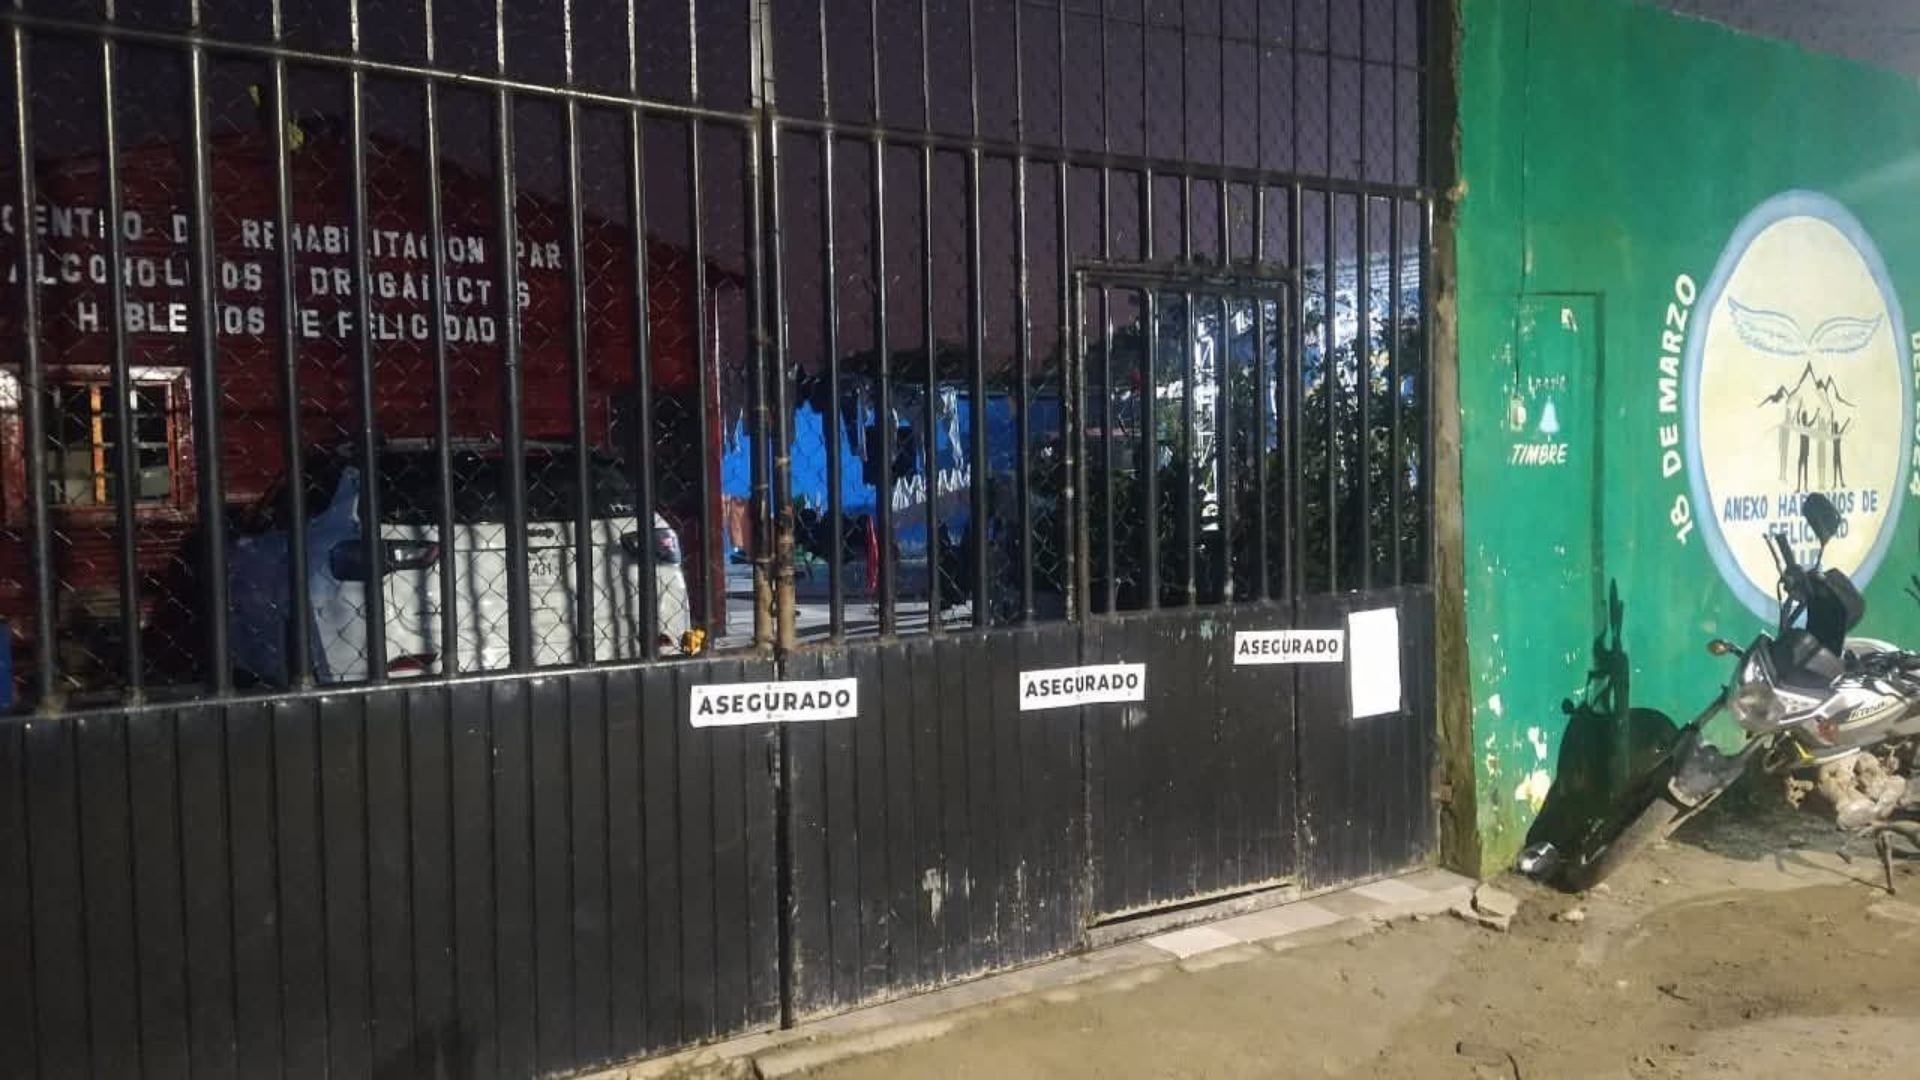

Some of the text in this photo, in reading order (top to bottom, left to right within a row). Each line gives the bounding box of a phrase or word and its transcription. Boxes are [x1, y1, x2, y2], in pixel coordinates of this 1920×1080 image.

[1, 204, 142, 241] CENTO
[8, 253, 530, 309] LCOOLOS DRGAICTS
[77, 301, 265, 335] HBLEOS
[337, 311, 496, 343] FLICDAD
[1658, 273, 1697, 545] 18 DE MARZO
[1511, 443, 1568, 465] TIMBRE
[1723, 495, 1768, 522] ANEXO
[1862, 490, 1878, 513] DE
[1238, 638, 1338, 656] ASEGURADO
[1025, 673, 1138, 698] ASEGURADO
[697, 689, 851, 716] ASEGURADO
